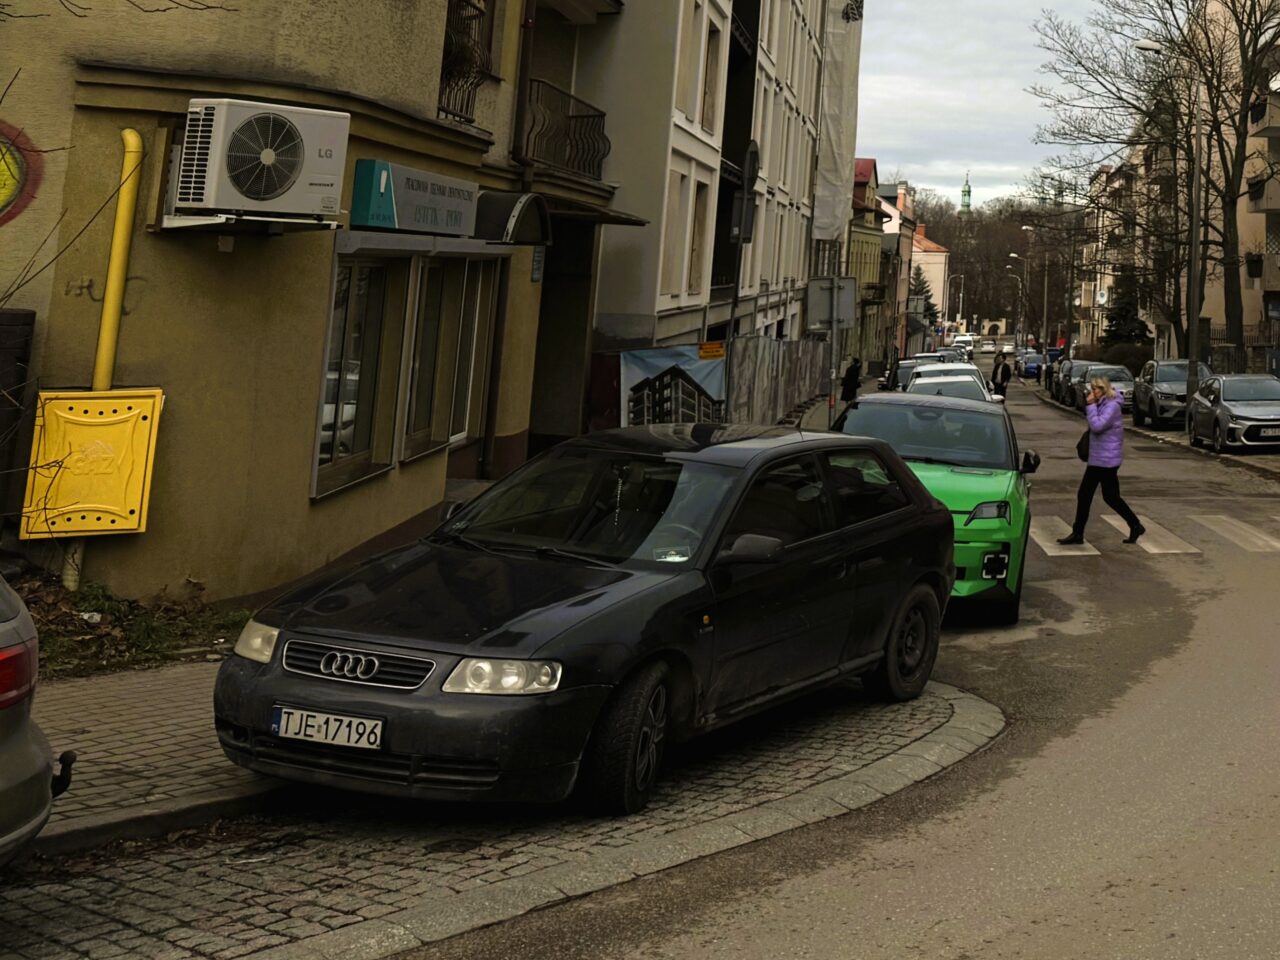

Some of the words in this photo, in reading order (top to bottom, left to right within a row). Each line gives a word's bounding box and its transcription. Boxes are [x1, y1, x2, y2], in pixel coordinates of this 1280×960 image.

[317, 147, 334, 159] LG
[283, 711, 317, 738] TJE
[323, 717, 379, 746] 17196
